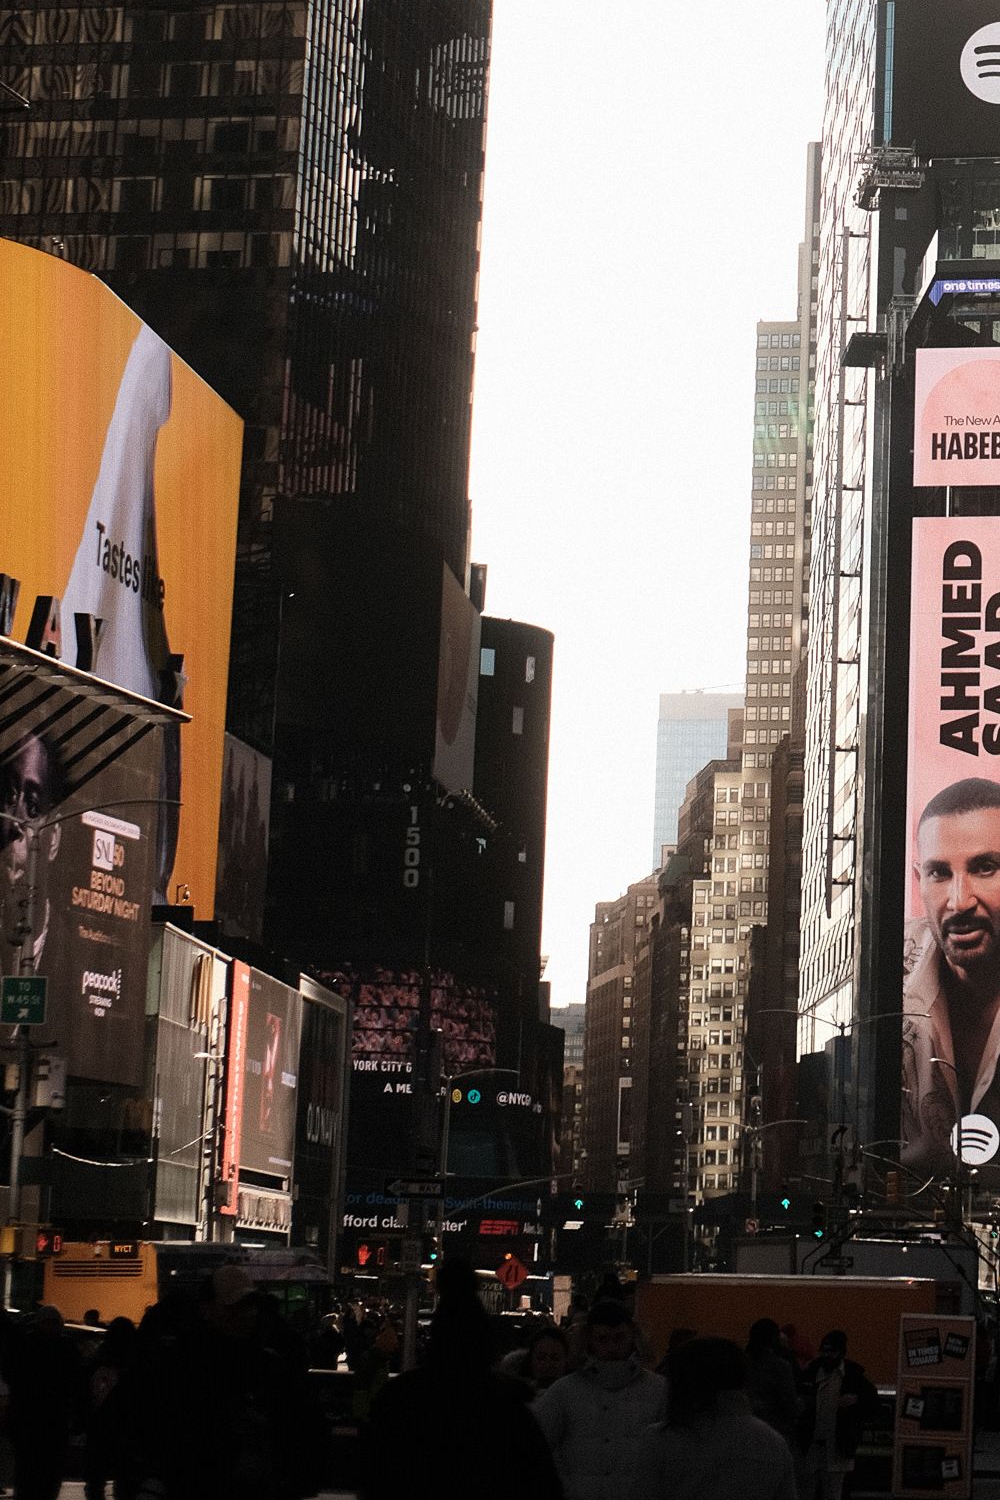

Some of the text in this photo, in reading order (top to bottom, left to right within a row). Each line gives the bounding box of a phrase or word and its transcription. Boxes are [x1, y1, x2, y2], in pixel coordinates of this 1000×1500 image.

[943, 280, 966, 291] one
[967, 280, 1000, 290] times
[944, 416, 965, 426] The
[966, 415, 992, 425] New
[96, 520, 140, 593] Tastes
[939, 540, 983, 757] AHMED
[90, 870, 126, 897] BEYOND
[71, 886, 141, 922] SATURDAY NIGHT
[82, 970, 118, 994] peacock
[353, 1059, 378, 1072] YORK
[380, 1060, 402, 1073] CITY
[383, 1082, 393, 1093] A
